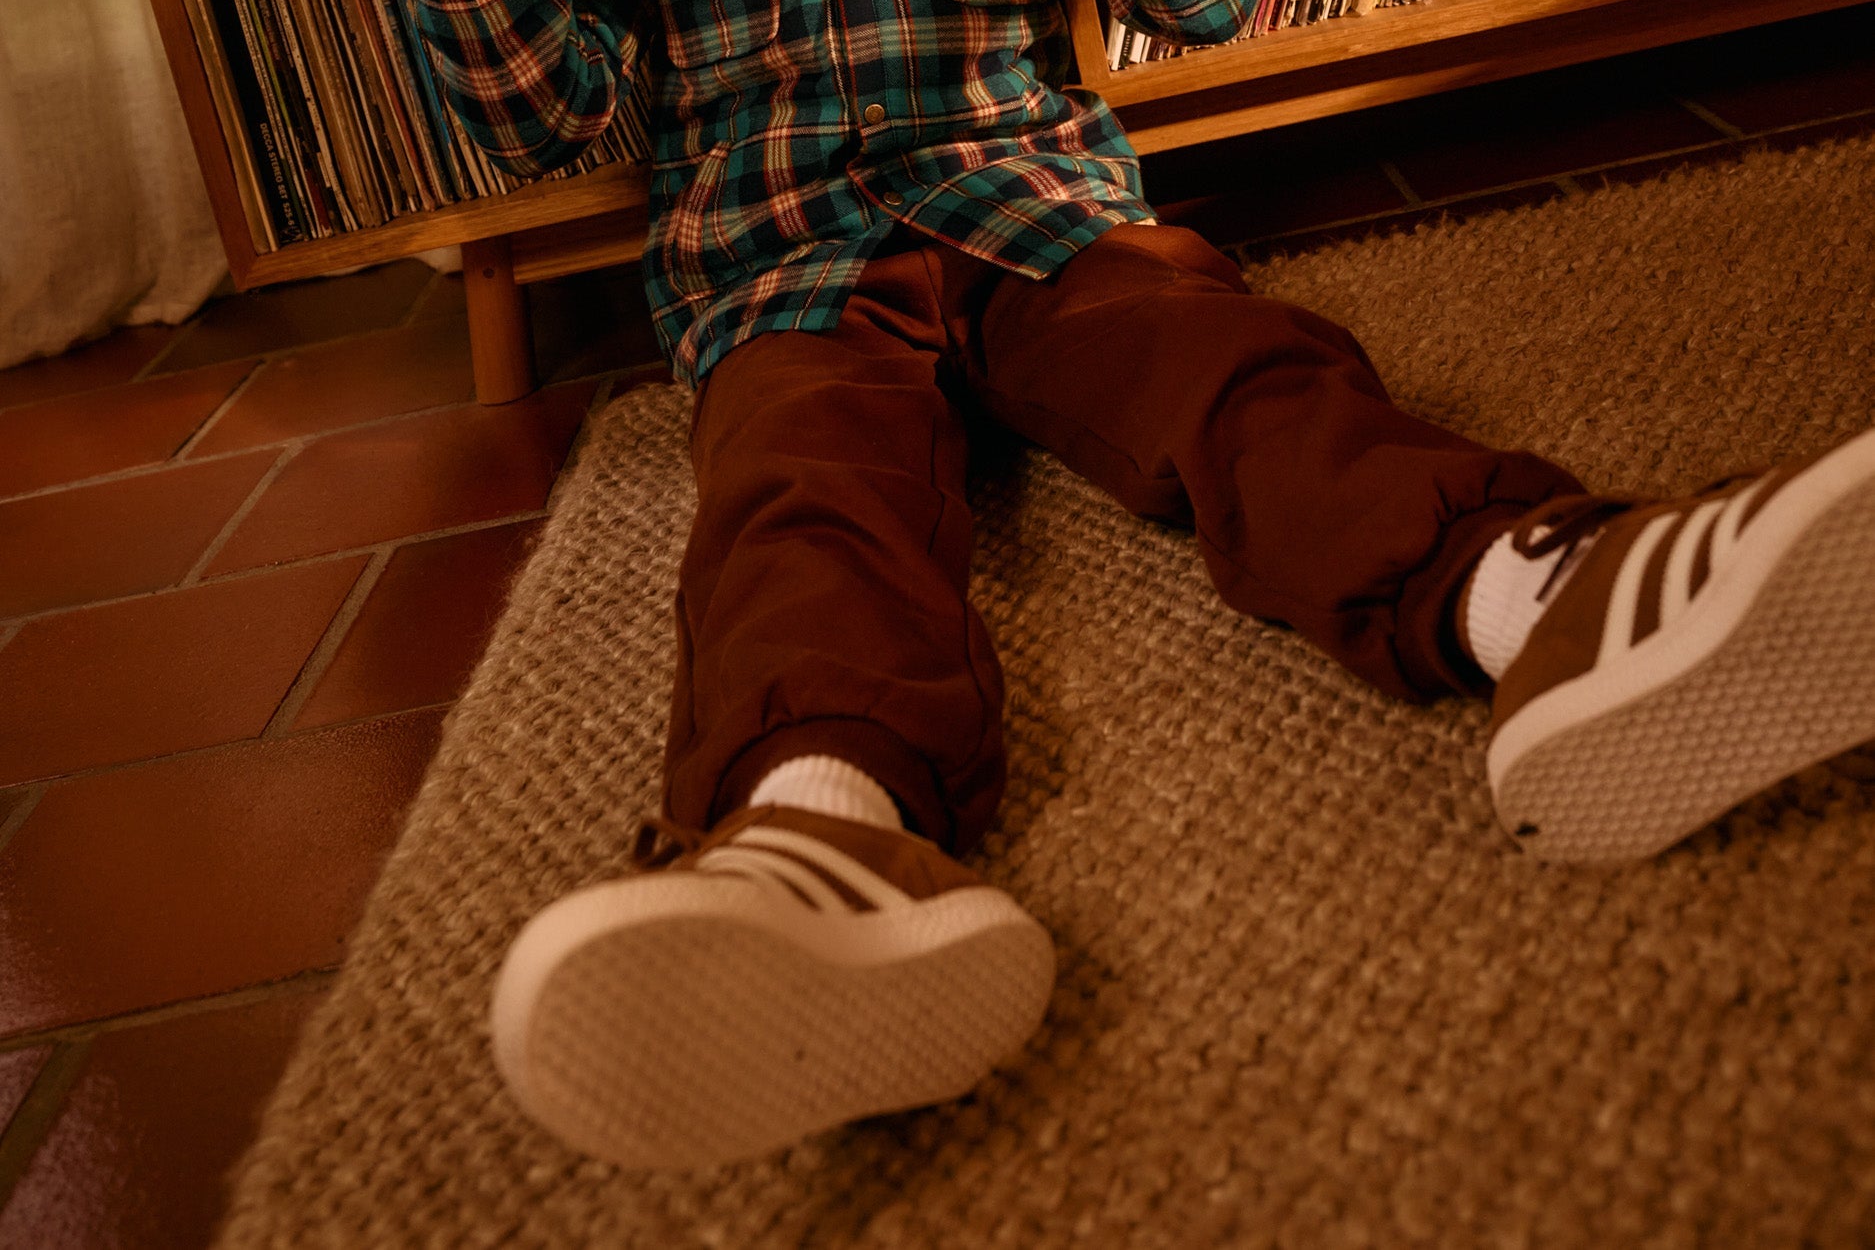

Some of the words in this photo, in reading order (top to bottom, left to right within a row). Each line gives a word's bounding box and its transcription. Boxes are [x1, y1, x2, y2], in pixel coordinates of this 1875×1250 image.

[260, 122, 274, 151] DECCA
[269, 152, 284, 183] STEREO
[277, 184, 288, 199] SET
